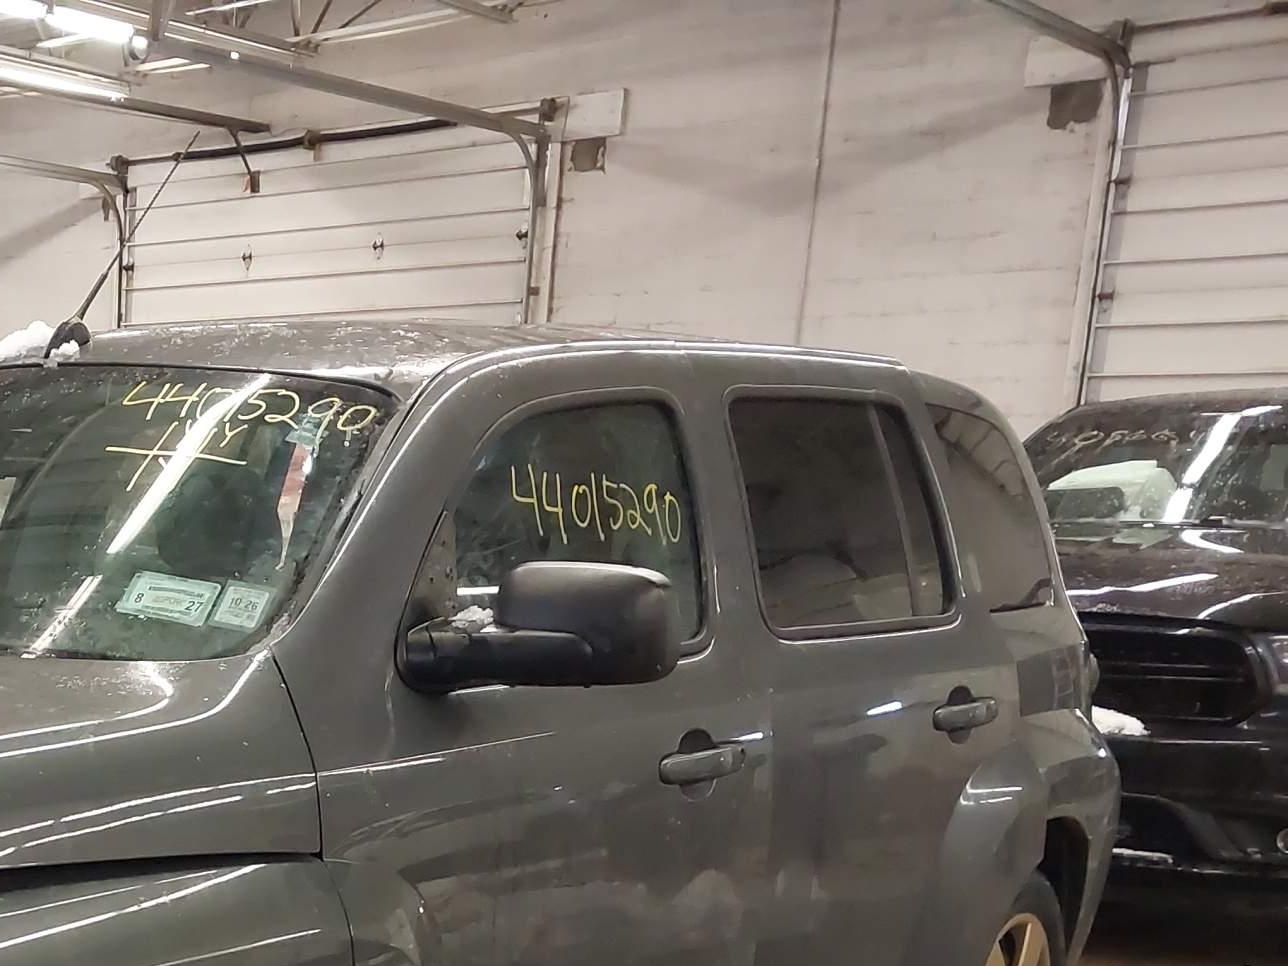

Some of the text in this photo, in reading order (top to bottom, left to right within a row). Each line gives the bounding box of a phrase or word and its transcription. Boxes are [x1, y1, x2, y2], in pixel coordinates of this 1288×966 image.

[510, 463, 682, 546] 44015290
[134, 592, 145, 604] 8
[184, 600, 204, 613] 27
